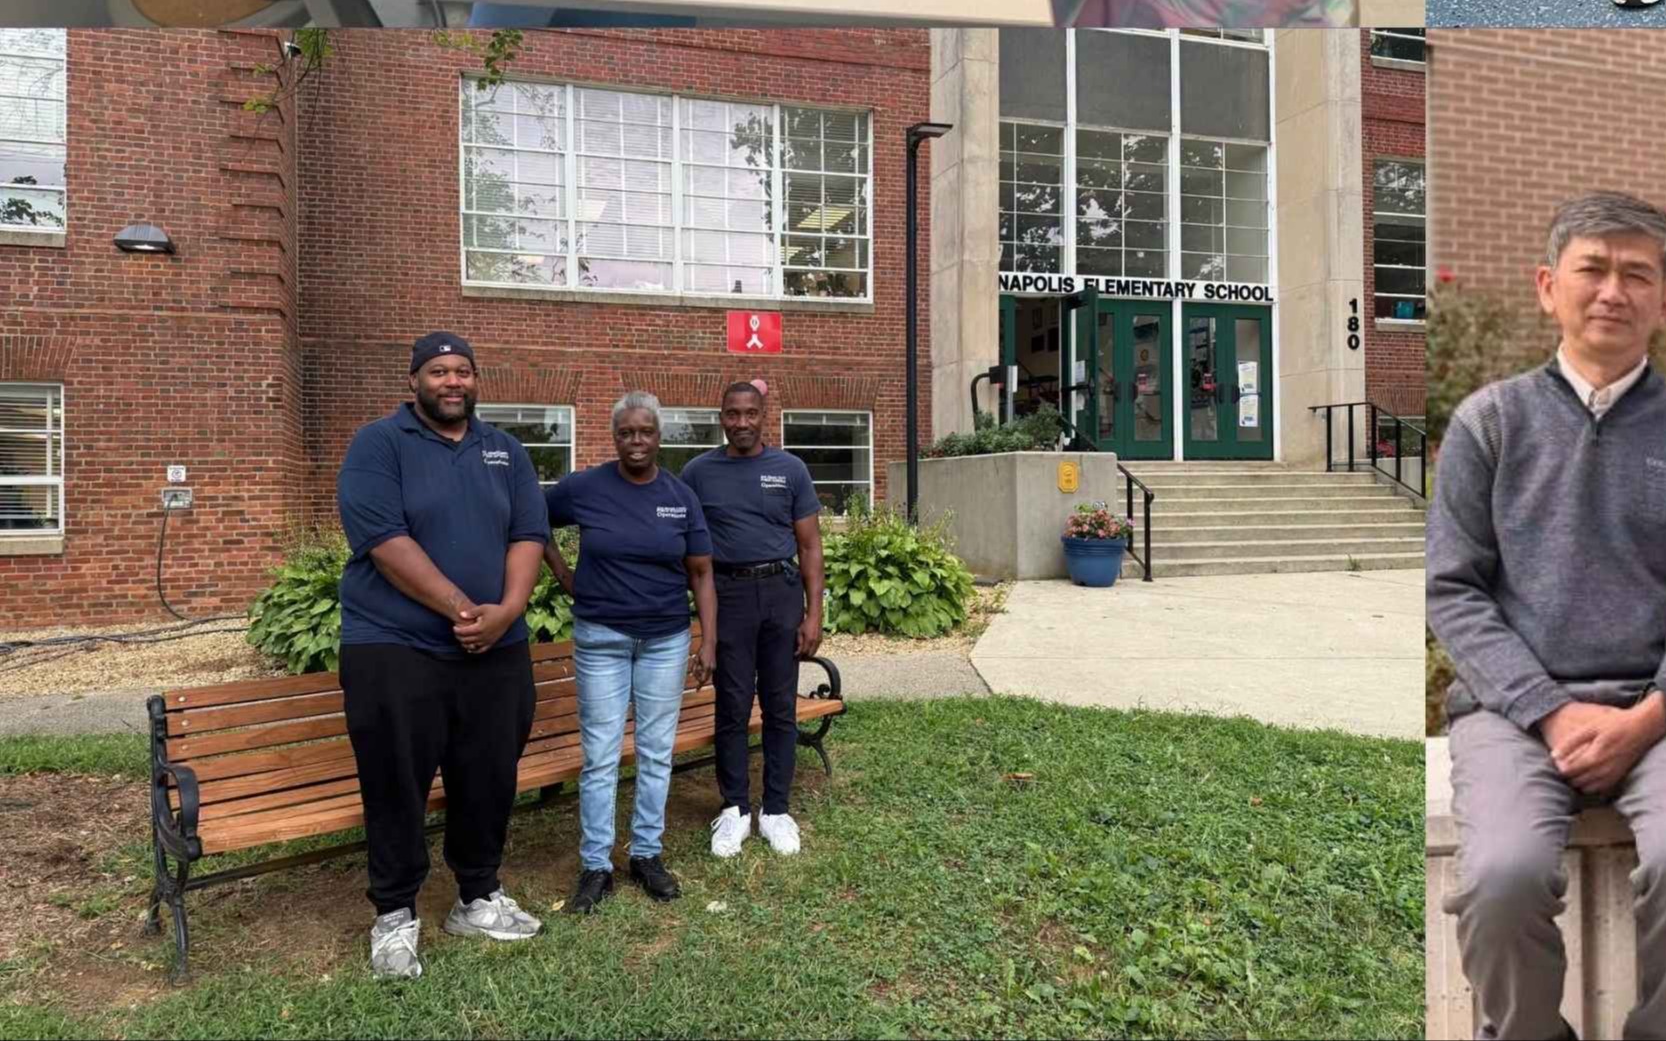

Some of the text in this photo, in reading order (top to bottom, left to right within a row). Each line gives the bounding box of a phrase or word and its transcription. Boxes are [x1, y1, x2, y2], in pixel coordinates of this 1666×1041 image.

[1084, 278, 1196, 298] ELEMENTARY
[1204, 283, 1274, 302] SCHOOL
[1347, 297, 1360, 350] 180
